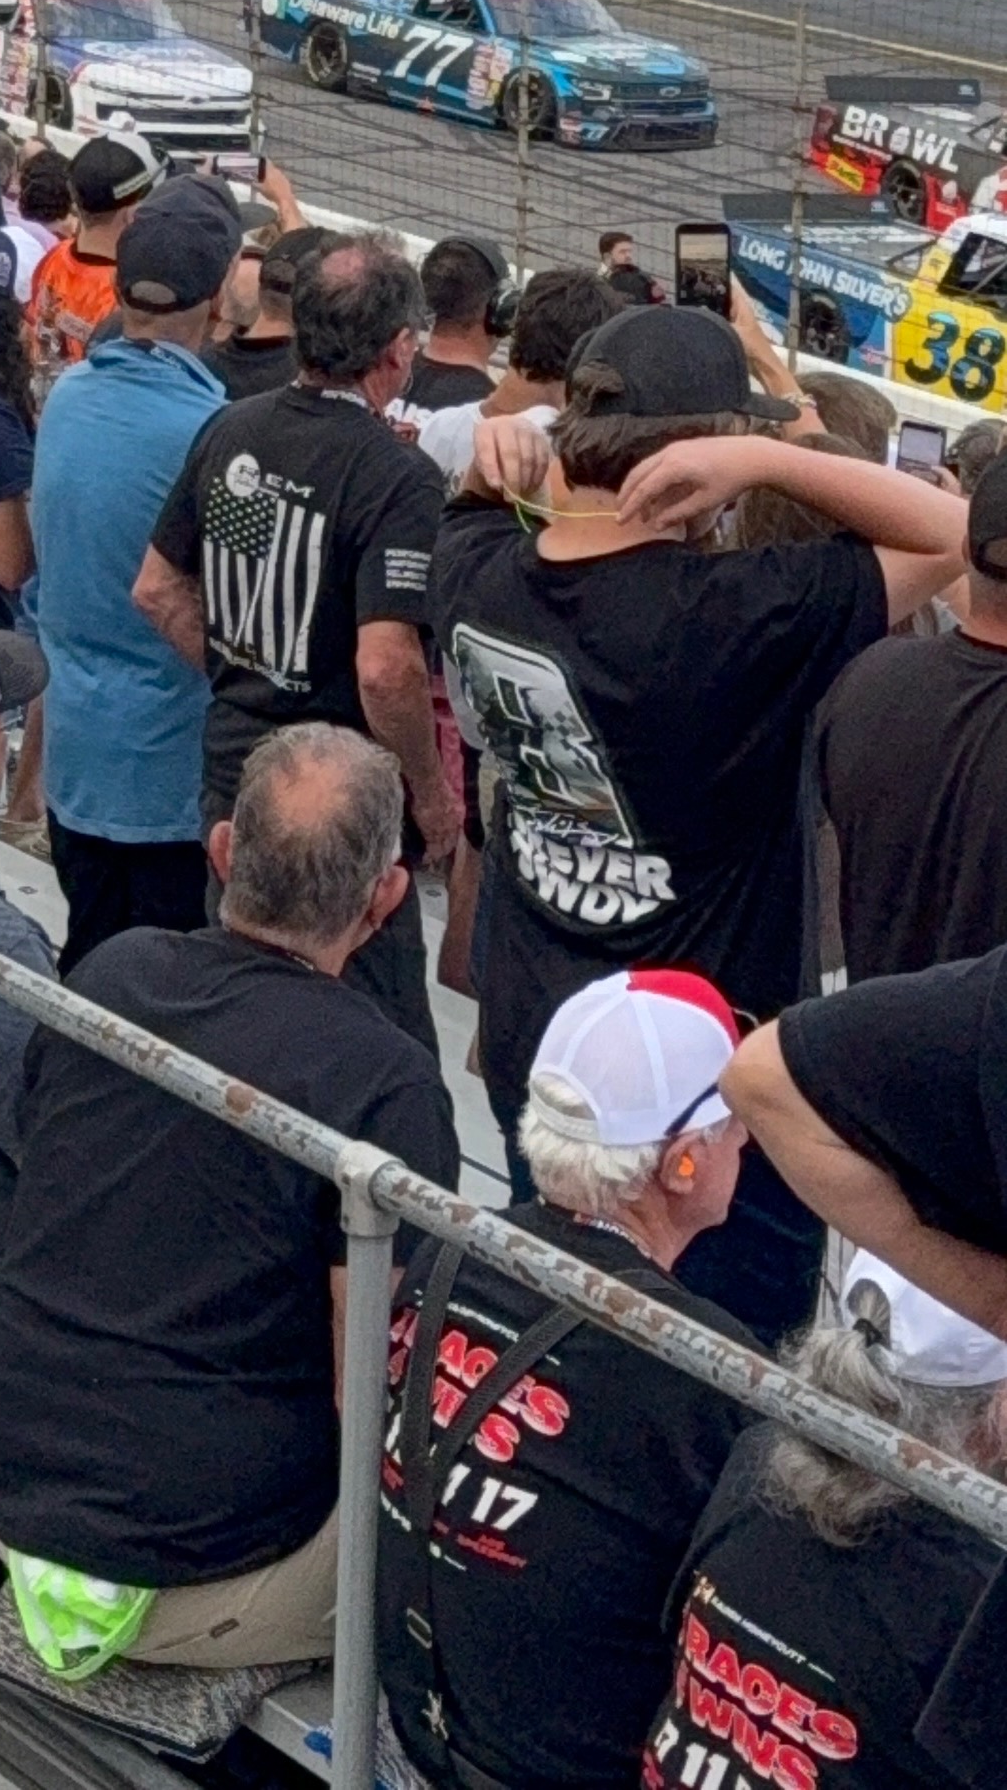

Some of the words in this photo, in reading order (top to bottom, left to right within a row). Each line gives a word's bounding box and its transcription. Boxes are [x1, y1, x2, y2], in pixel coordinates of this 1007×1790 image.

[394, 24, 474, 88] 77
[738, 235, 786, 272] LONG
[834, 270, 908, 318] SILVER'S
[904, 310, 1006, 402] 38
[470, 1475, 539, 1531] 17
[685, 1612, 858, 1761] RACES
[689, 1675, 819, 1790] WINS
